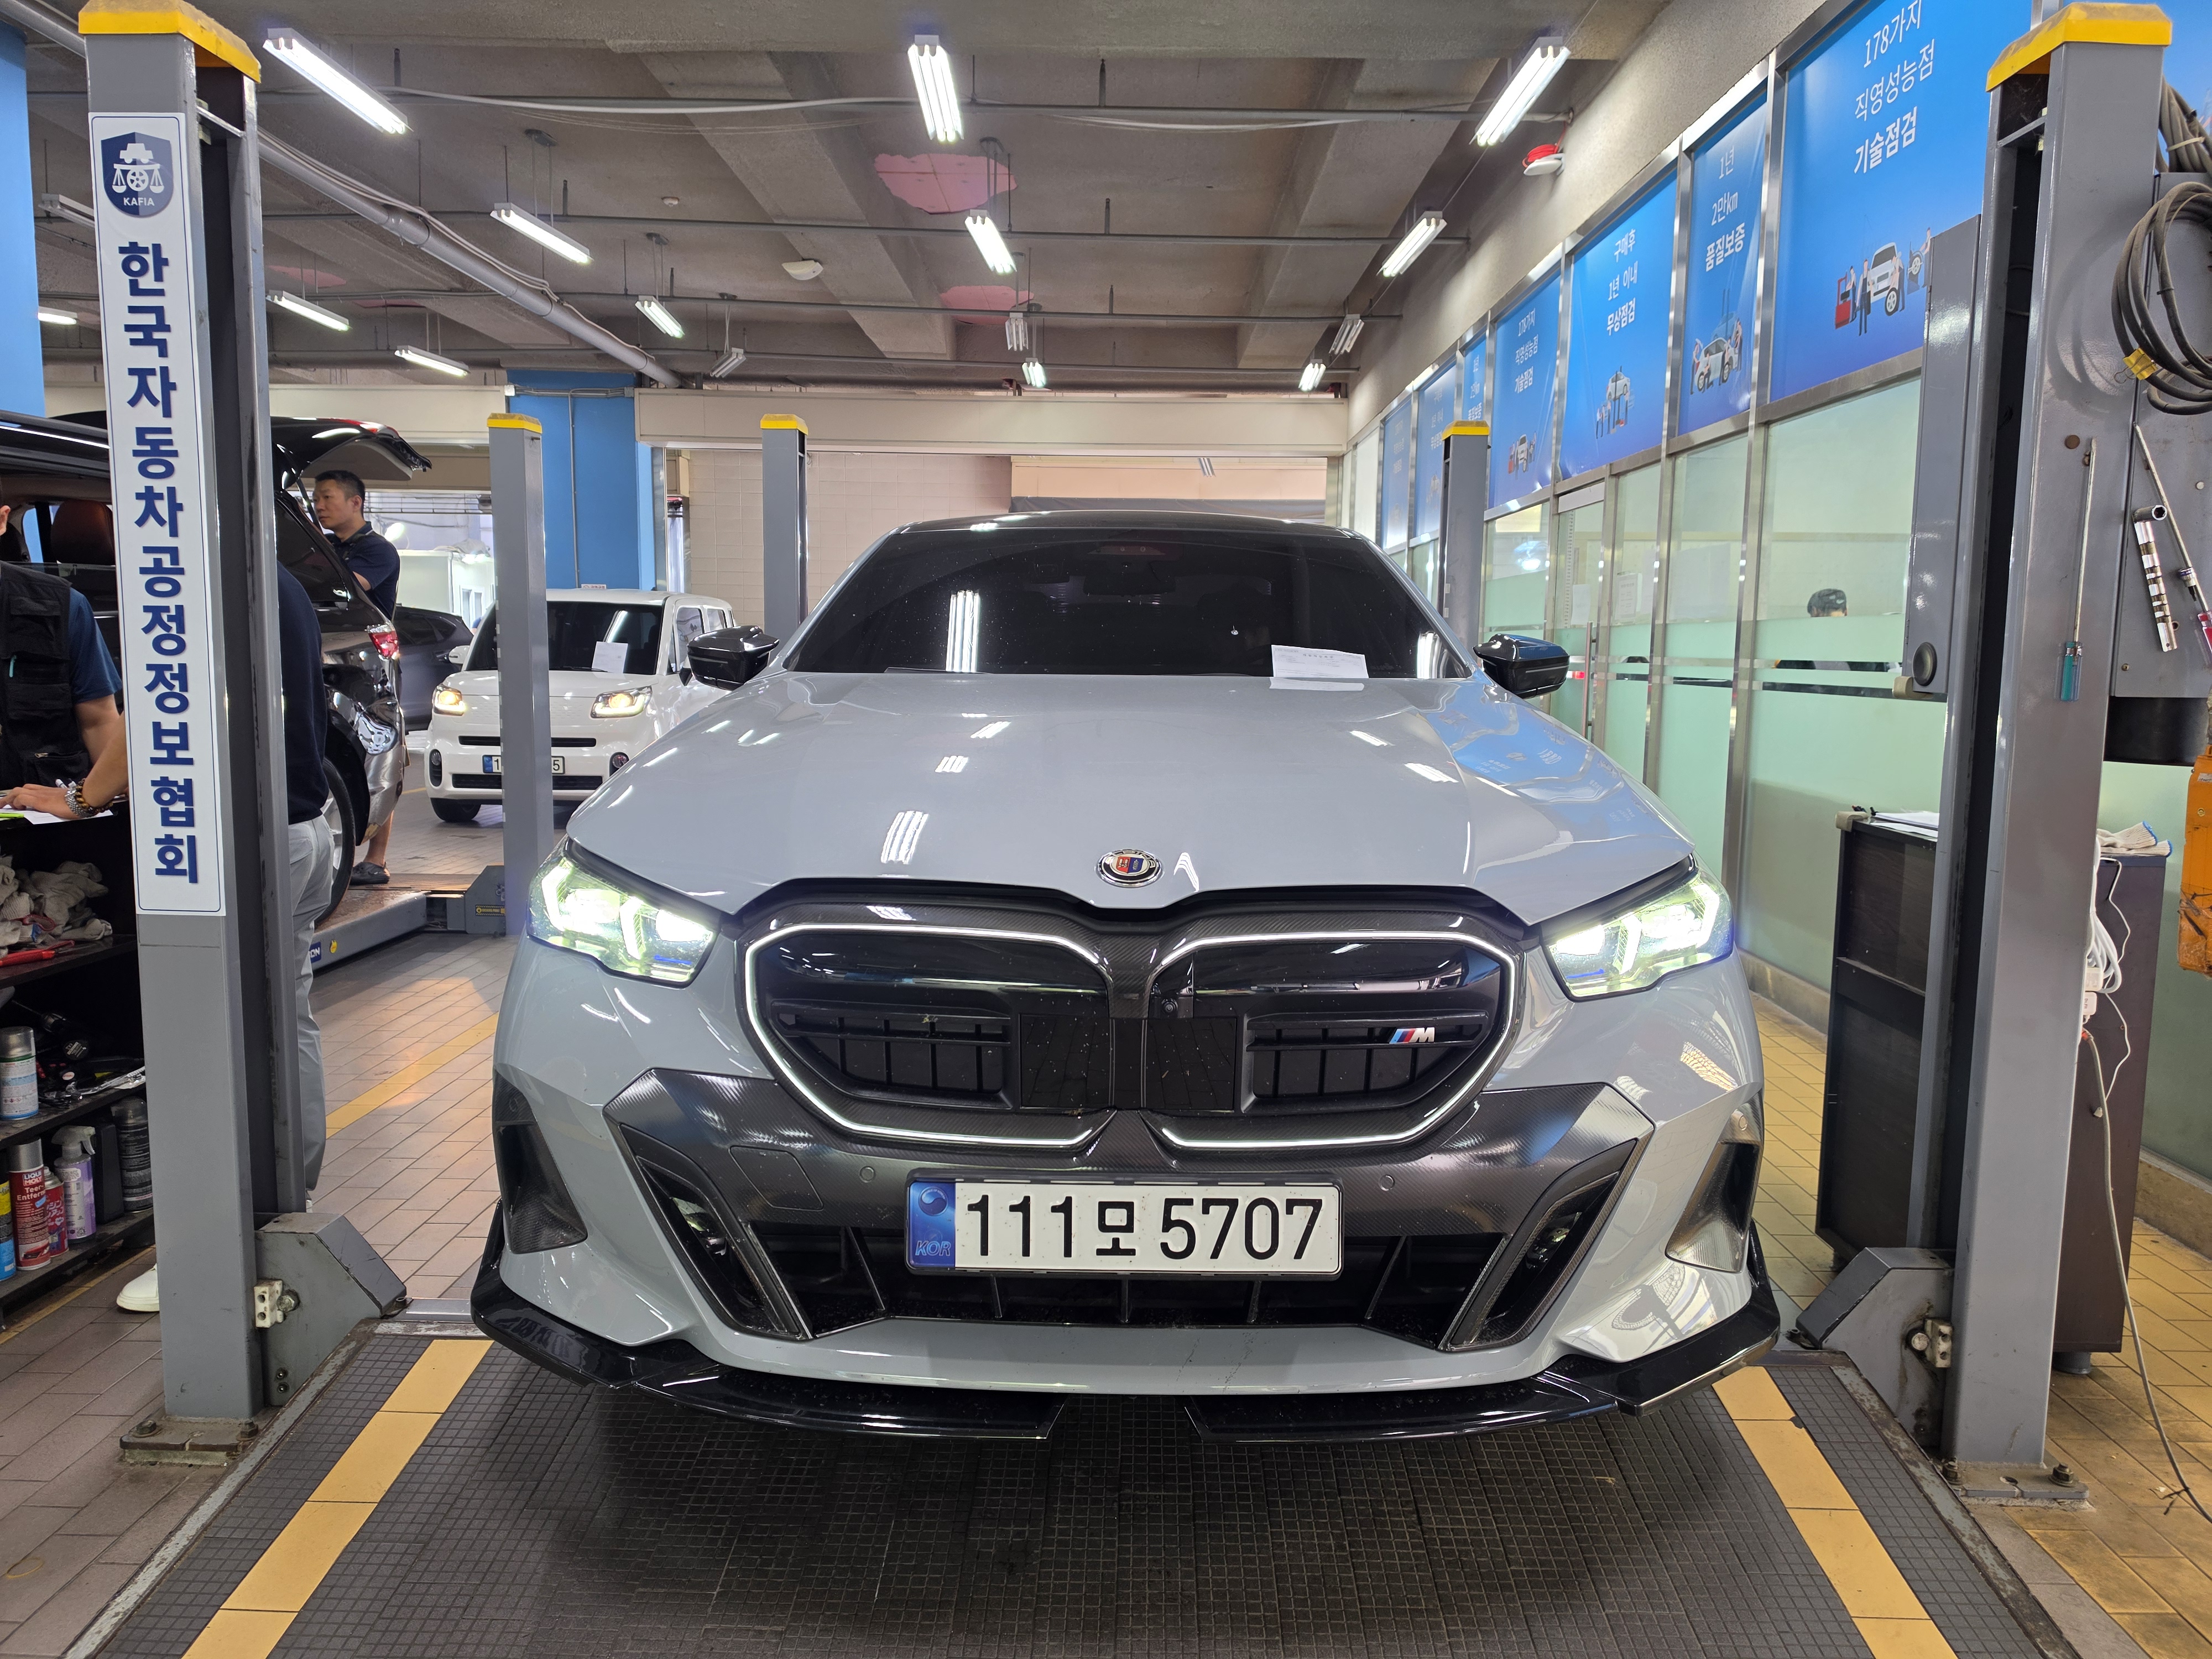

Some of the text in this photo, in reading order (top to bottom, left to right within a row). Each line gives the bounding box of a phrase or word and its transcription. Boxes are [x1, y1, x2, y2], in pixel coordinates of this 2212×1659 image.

[1864, 0, 1922, 68] 178가지
[1855, 38, 1935, 122] 직영성능점
[1854, 106, 1917, 174] 기술점검
[1719, 145, 1735, 179] 1년
[123, 197, 155, 206] KAFIA
[1712, 191, 1738, 226] 2만km
[1614, 228, 1636, 263] 구매후
[1705, 222, 1745, 272] 품질보증
[1608, 260, 1638, 301] 1년 이내
[1606, 297, 1636, 336] 무상점검
[118, 241, 198, 884] 한국자동차공정정보협회
[310, 947, 320, 958] ON
[24, 1171, 42, 1180] LIQUI
[24, 1176, 42, 1185] MOLY
[967, 1194, 1323, 1260] 111모 5707
[915, 1240, 951, 1256] KOR
